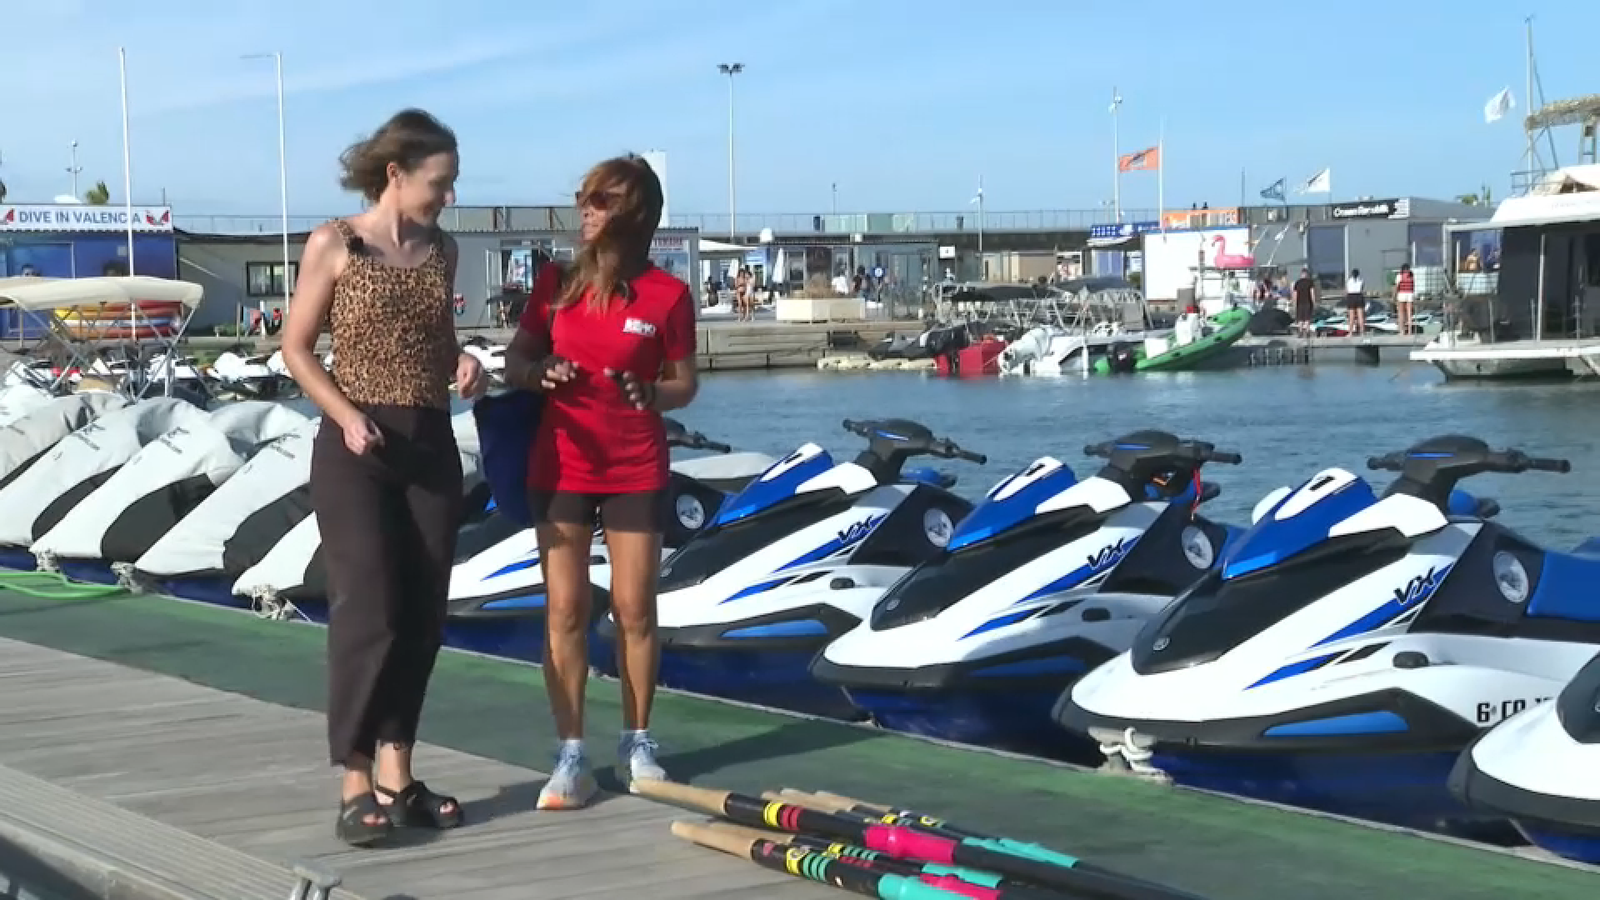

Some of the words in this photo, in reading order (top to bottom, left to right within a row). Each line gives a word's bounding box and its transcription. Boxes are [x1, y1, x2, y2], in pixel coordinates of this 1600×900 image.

[19, 211, 51, 223] DIVE
[55, 212, 70, 223] IN
[73, 212, 142, 224] VALENCA
